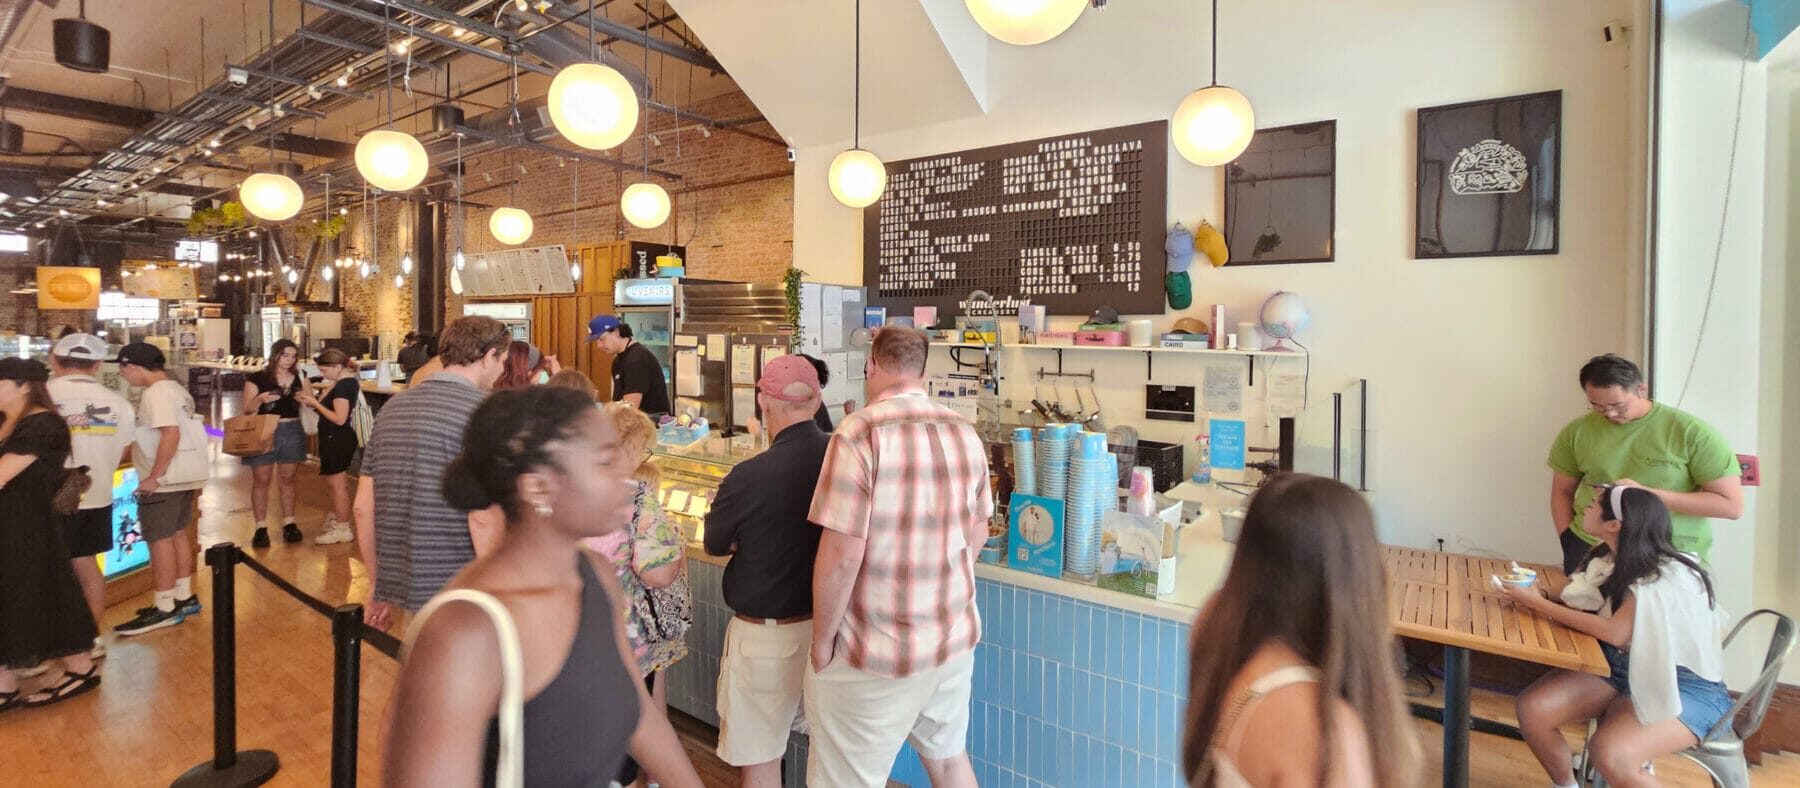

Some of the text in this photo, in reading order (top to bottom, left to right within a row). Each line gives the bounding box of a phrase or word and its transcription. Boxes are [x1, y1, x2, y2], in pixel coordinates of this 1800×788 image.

[1038, 137, 1092, 153] SEASONAL
[1003, 140, 1142, 168] ORANGE FLOWER BAKLAVA
[910, 156, 961, 172] SIGNATURES
[1003, 153, 1120, 177] AUSTRALIAN PAVLOVA
[886, 173, 910, 184] TICKY
[914, 169, 935, 180] RICE
[1003, 164, 1113, 186] SPANISH GIN TONIC
[900, 187, 930, 198] MALTED
[1003, 184, 1026, 195] THAI
[1059, 182, 1127, 198] SUGAR BOBA
[880, 196, 924, 209] VEGAN UBE
[1072, 194, 1113, 207] BUTTER
[880, 205, 914, 217] PASSION
[880, 205, 997, 224] ABUELITA MALTED CRUNCH
[1059, 205, 1099, 218] CRUNCH
[880, 223, 909, 233] KINDER
[880, 229, 929, 241] SMOKY ROAD
[880, 233, 990, 249] VIETNAMESE ROCKY ROAD
[880, 243, 973, 257] PANDAN TRES LECHES
[1020, 241, 1141, 258] SINGLE SPLIT 6.50
[880, 254, 940, 266] BLACK SESAME
[1020, 252, 1141, 267] TASTING TRIO 7.75
[880, 270, 957, 282] PISTACCHIO PURO
[1020, 266, 1044, 276] CONE
[1051, 265, 1064, 275] OR
[1071, 264, 1098, 275] BOWL
[879, 280, 934, 290] HOKEY POKEY
[1020, 275, 1071, 286] TOPPINGS
[1020, 282, 1140, 295] PREPACKED 13
